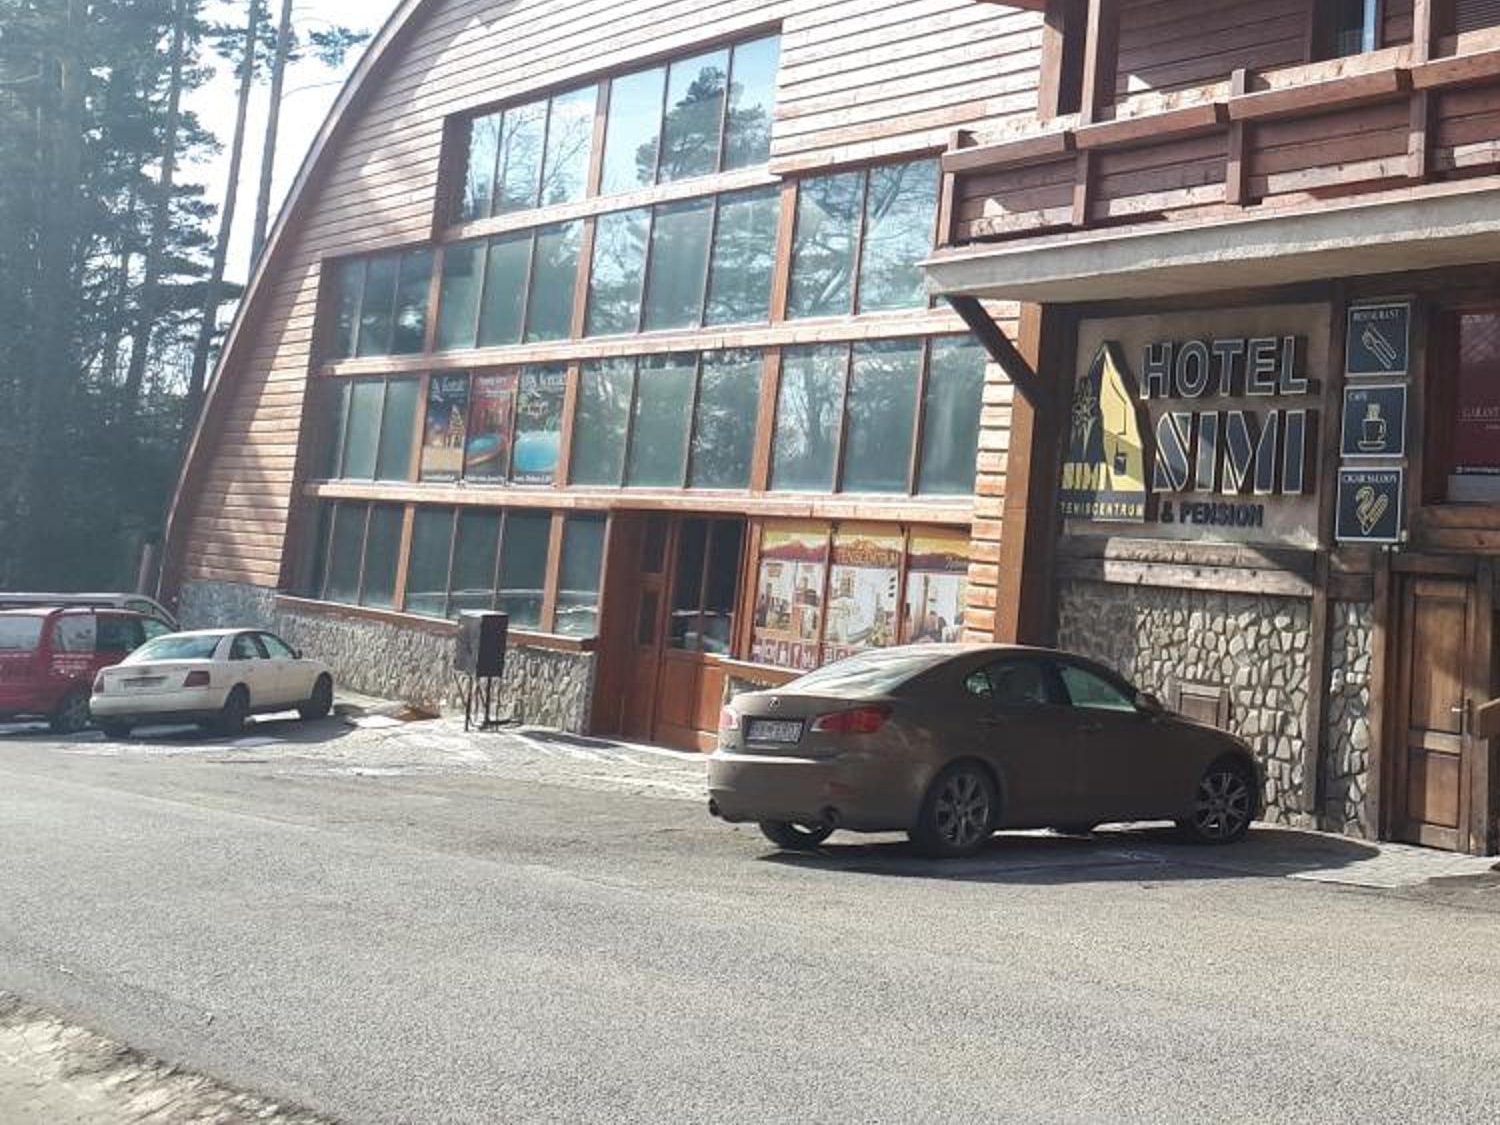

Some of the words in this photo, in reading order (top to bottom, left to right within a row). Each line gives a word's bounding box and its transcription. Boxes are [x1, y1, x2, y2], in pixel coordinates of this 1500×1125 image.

[1140, 336, 1308, 400] HOTEL
[1152, 410, 1306, 495] SIMI
[1161, 501, 1174, 523] &
[1180, 502, 1264, 527] PENSION
